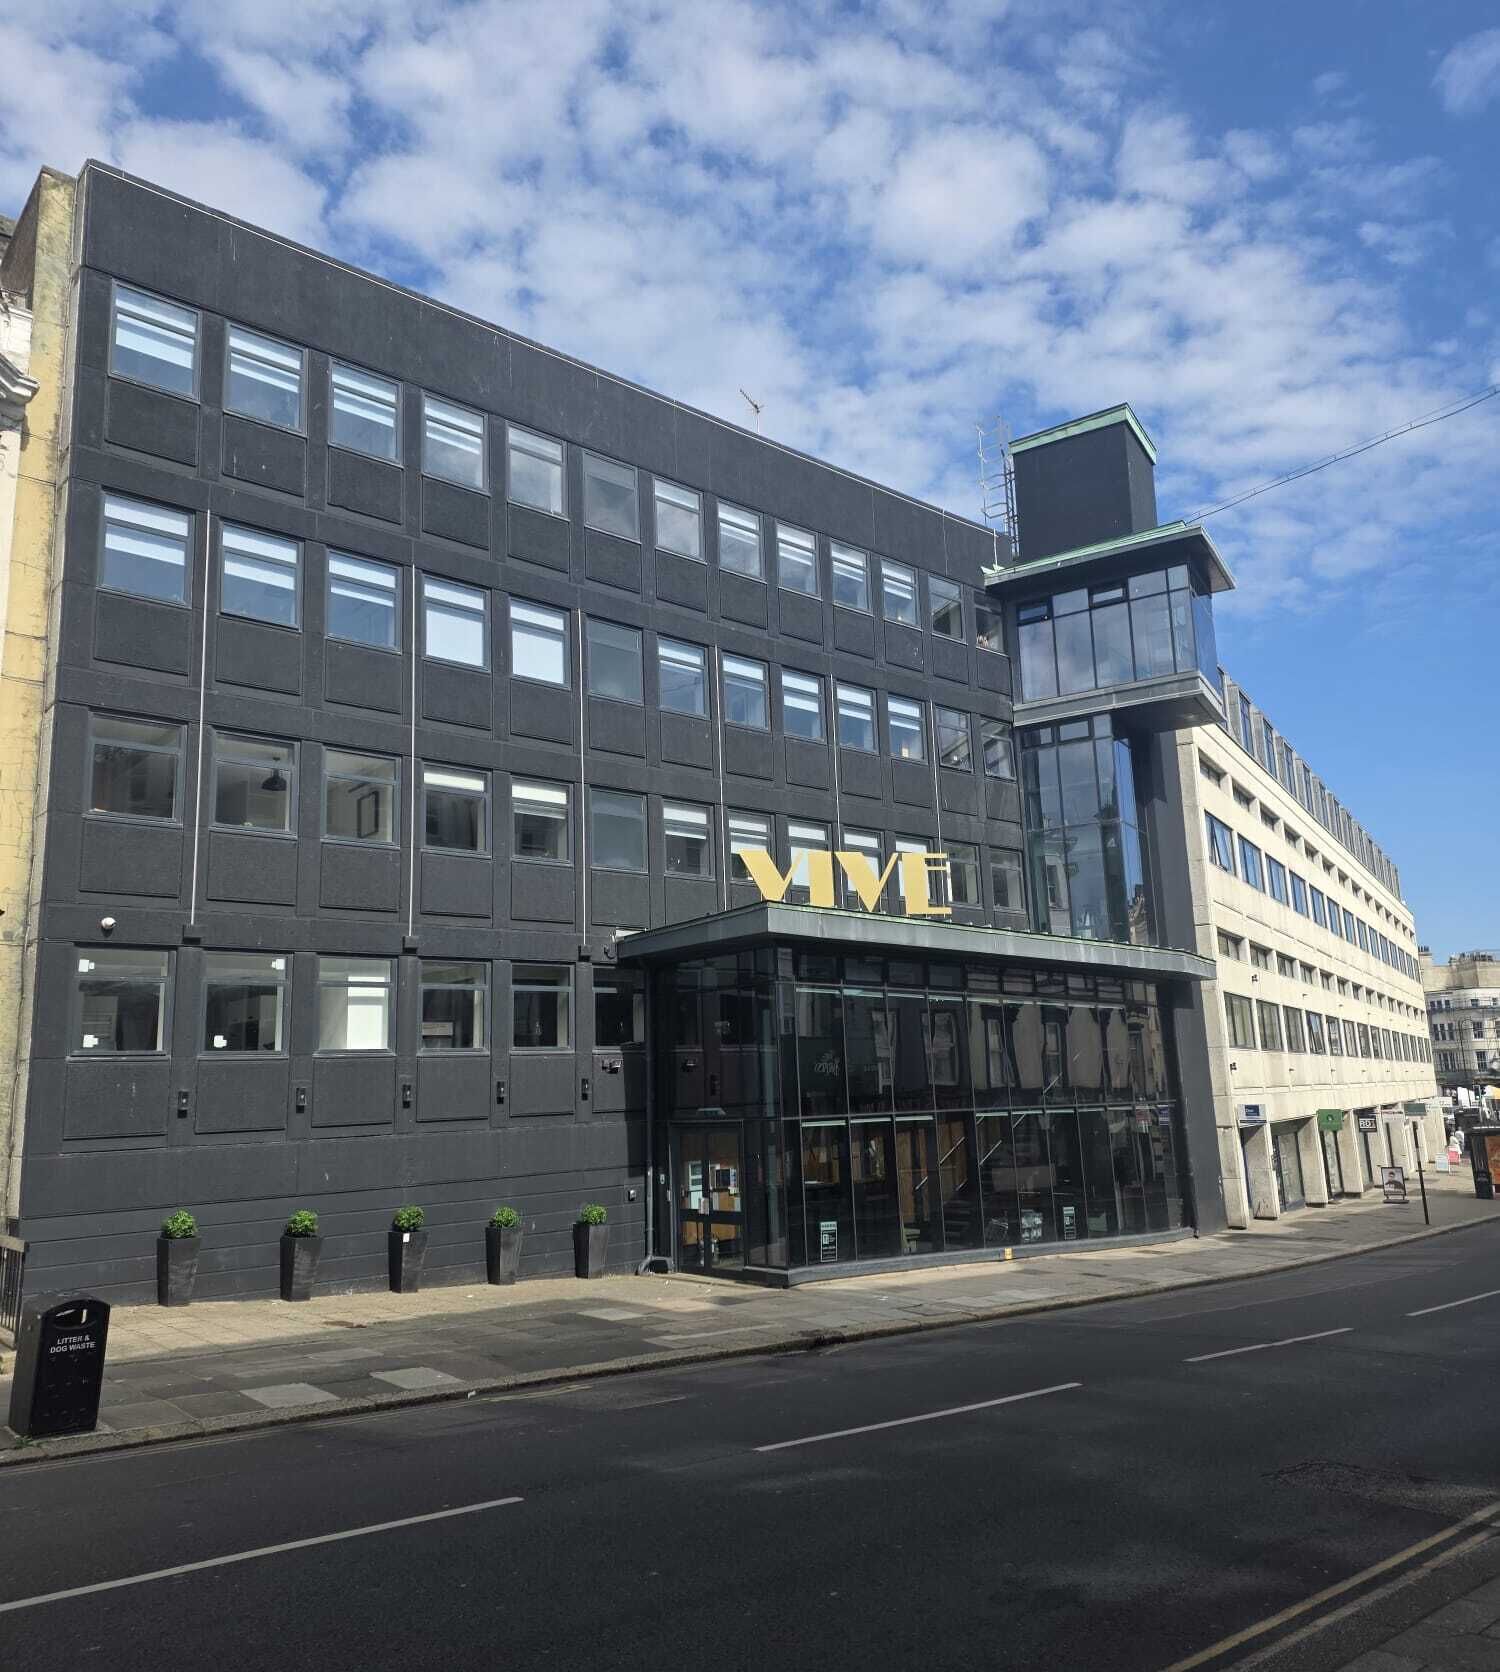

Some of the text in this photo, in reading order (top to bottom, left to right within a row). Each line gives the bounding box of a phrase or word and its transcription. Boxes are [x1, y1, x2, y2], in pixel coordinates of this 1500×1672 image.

[738, 850, 952, 915] VIVE
[57, 1334, 91, 1345] LITTER &
[50, 1341, 97, 1354] DOG WASTE
